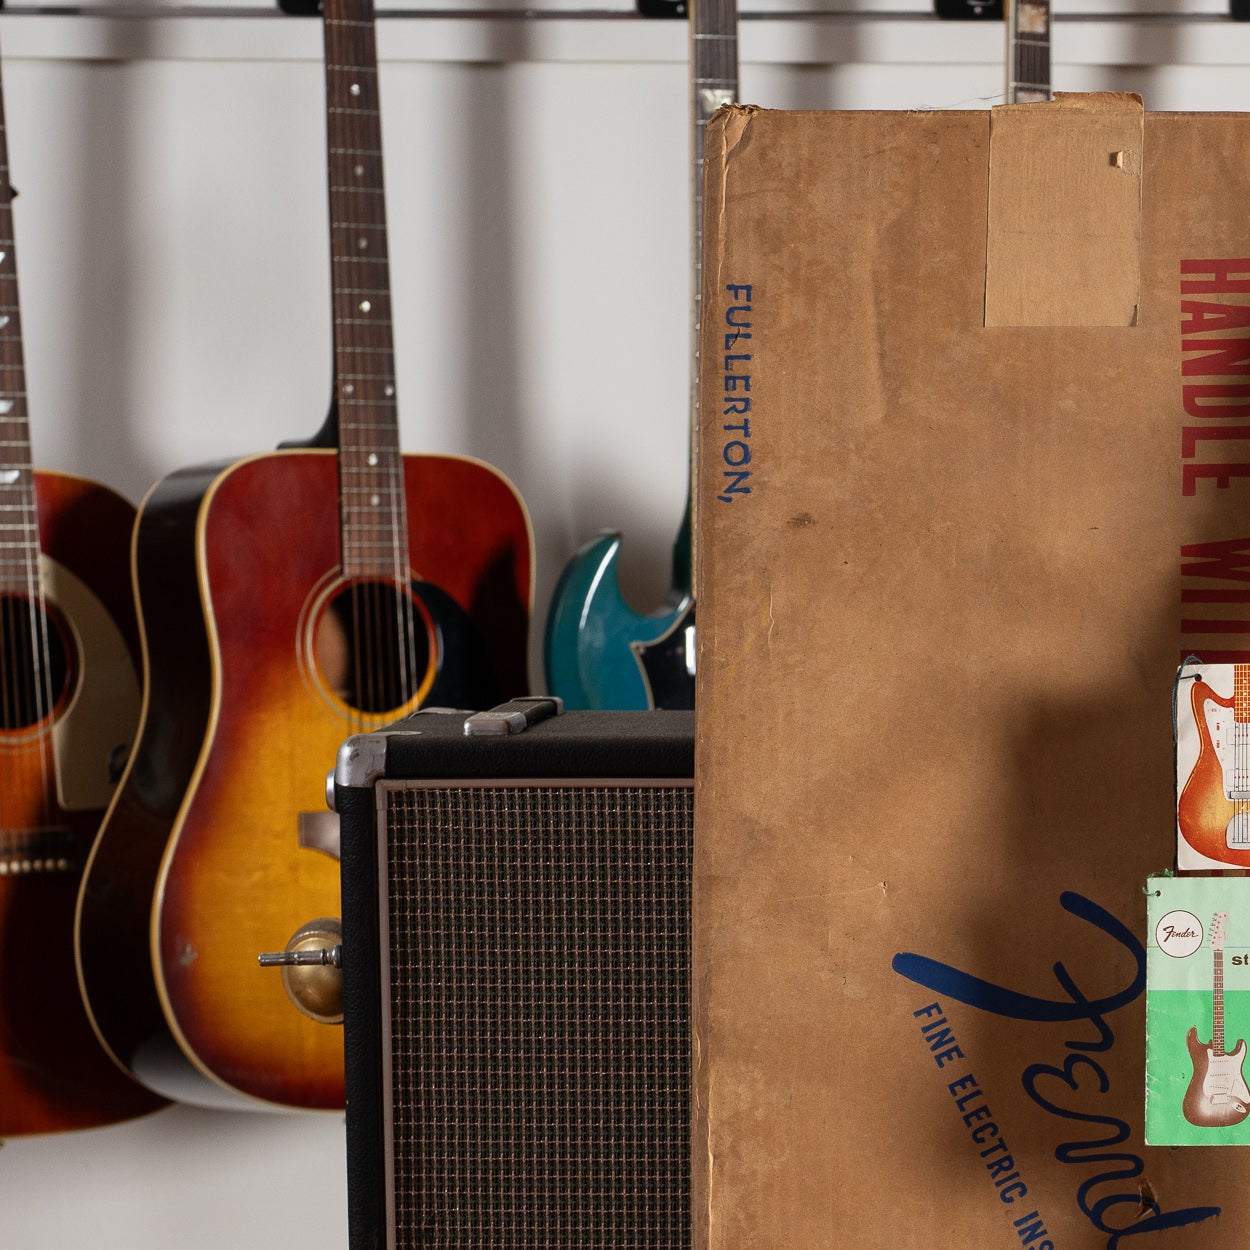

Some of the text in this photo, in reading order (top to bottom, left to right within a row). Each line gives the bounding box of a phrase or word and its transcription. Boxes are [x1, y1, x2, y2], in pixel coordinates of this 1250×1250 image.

[717, 283, 752, 503] FULLERTON,
[1163, 925, 1199, 942] Fender
[913, 1001, 965, 1068] FINE
[947, 1073, 1028, 1206] ELECTRIC
